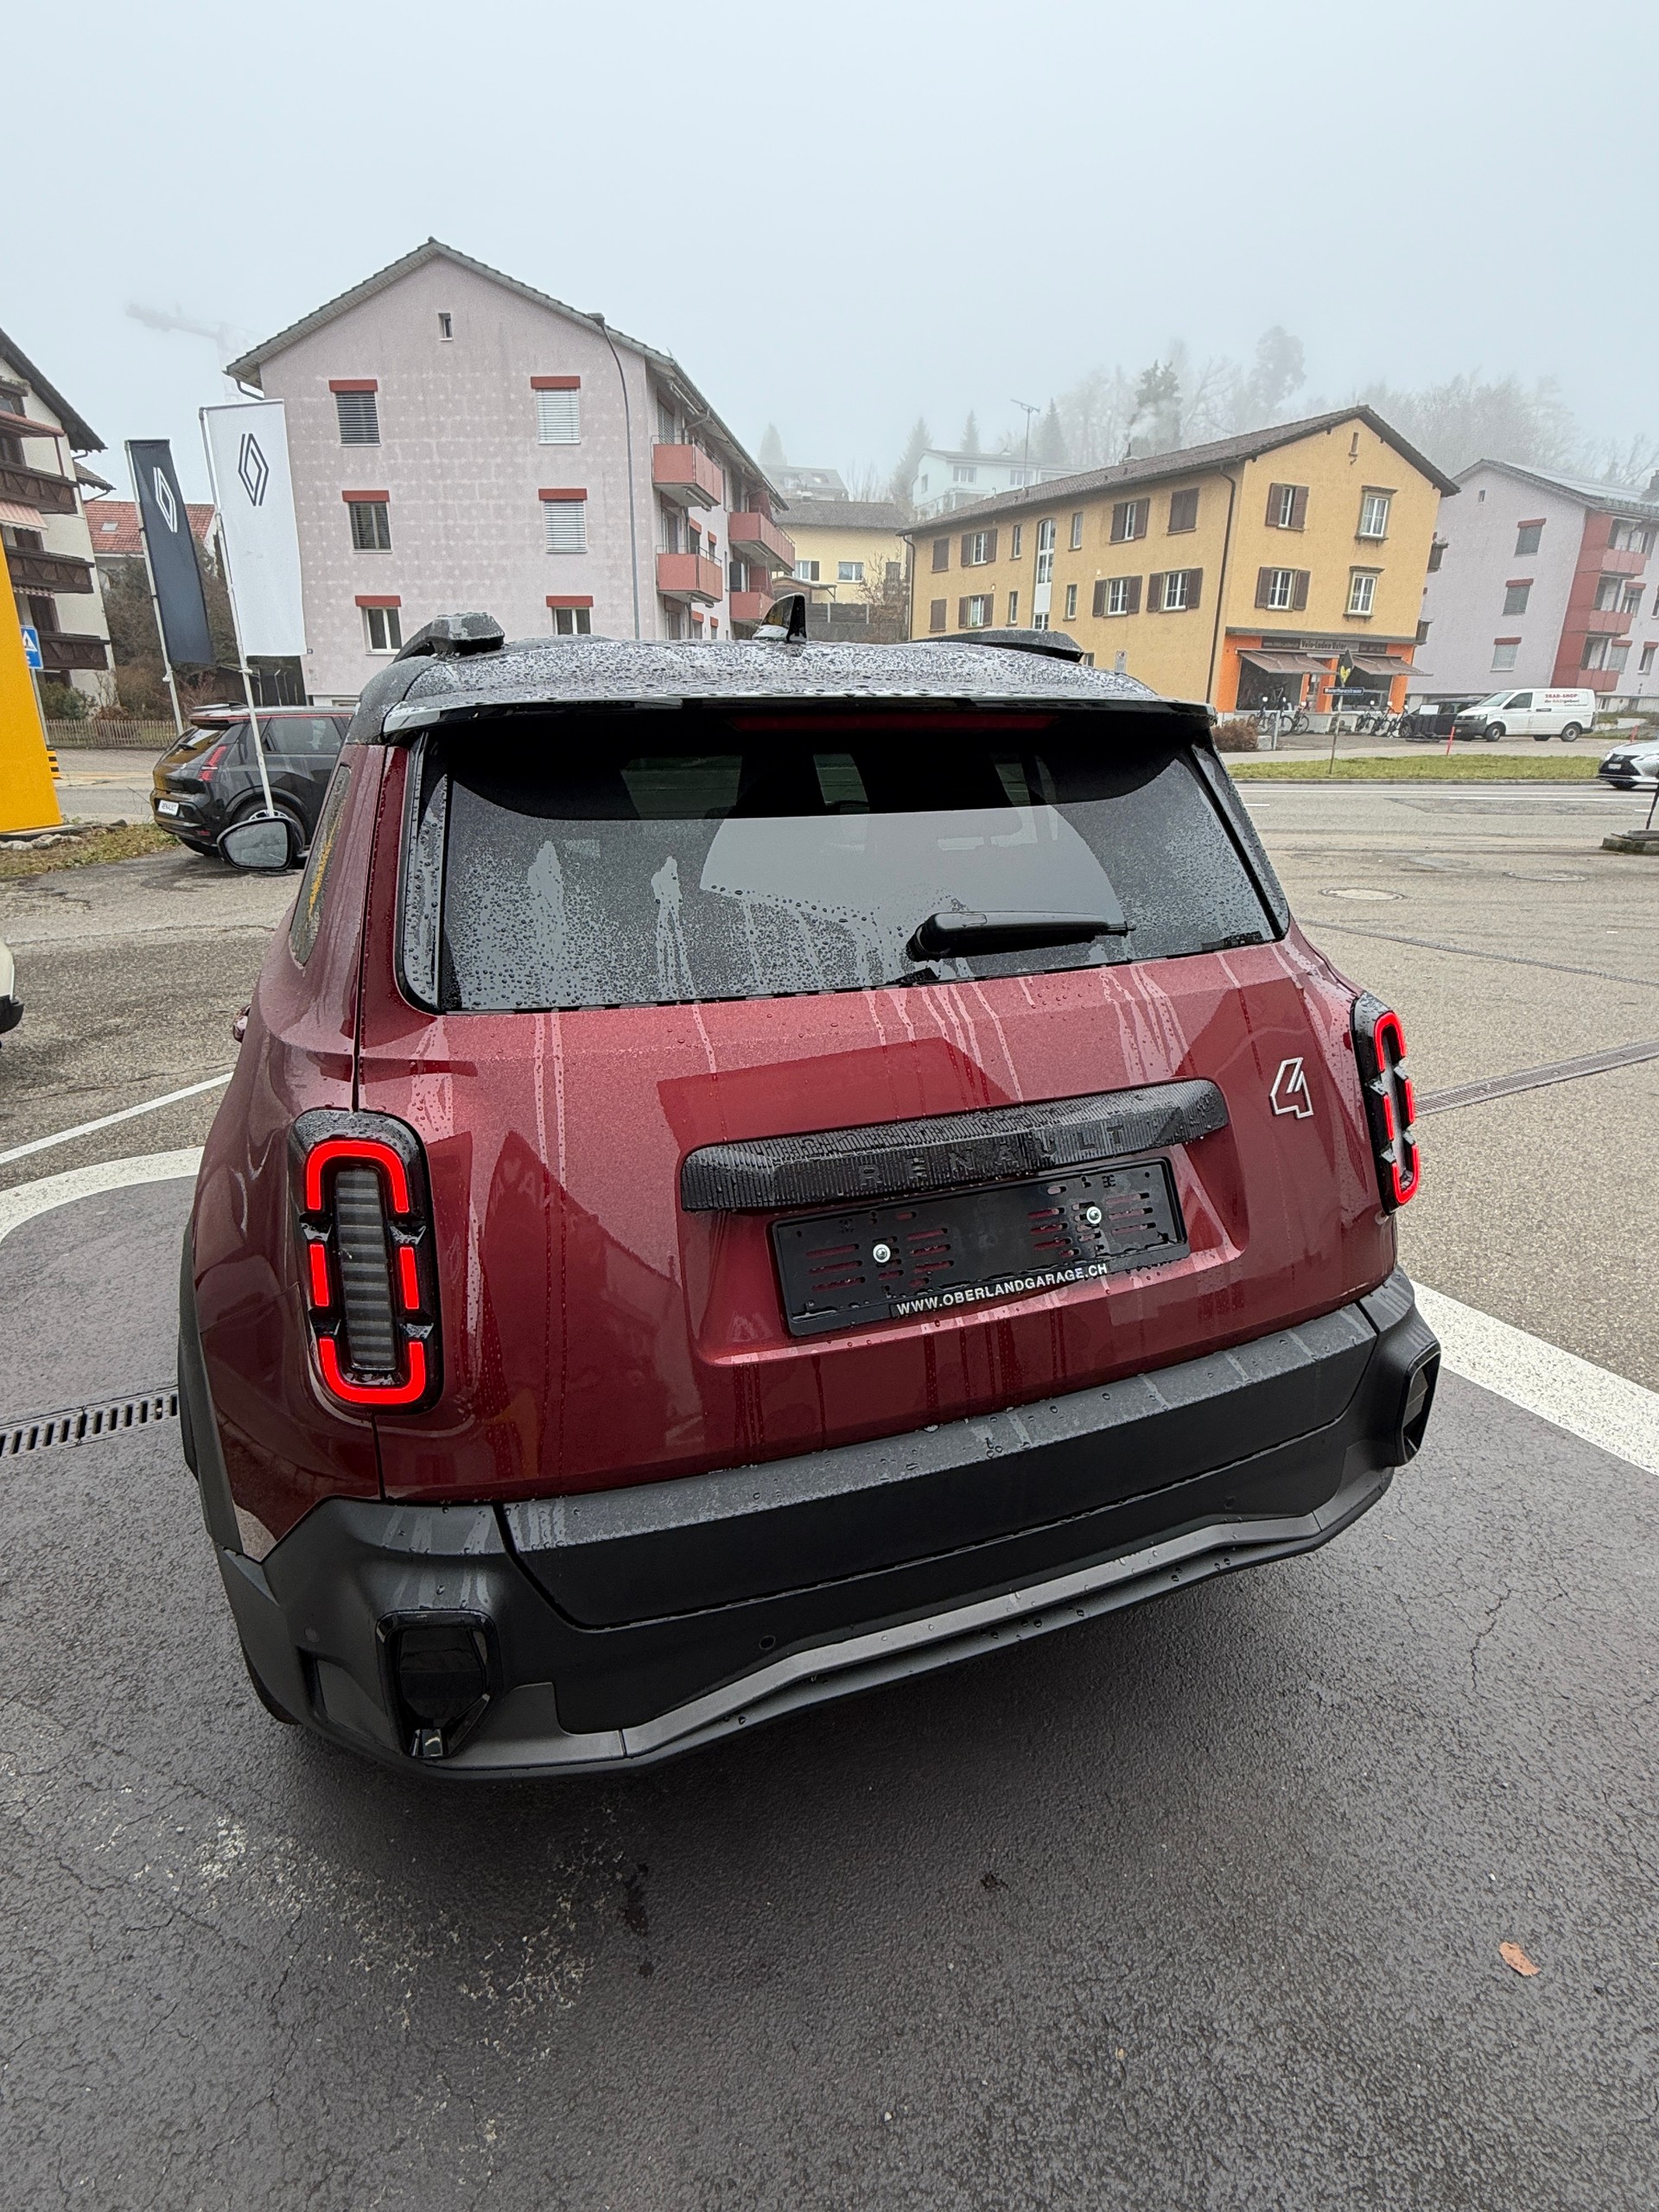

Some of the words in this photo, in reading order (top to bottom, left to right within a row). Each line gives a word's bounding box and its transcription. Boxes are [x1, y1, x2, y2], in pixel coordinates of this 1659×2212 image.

[1270, 1057, 1314, 1119] 4
[859, 1124, 1127, 1186] RENAULT
[896, 1263, 1109, 1316] WWW.OBERLANDGARAGE.CH
